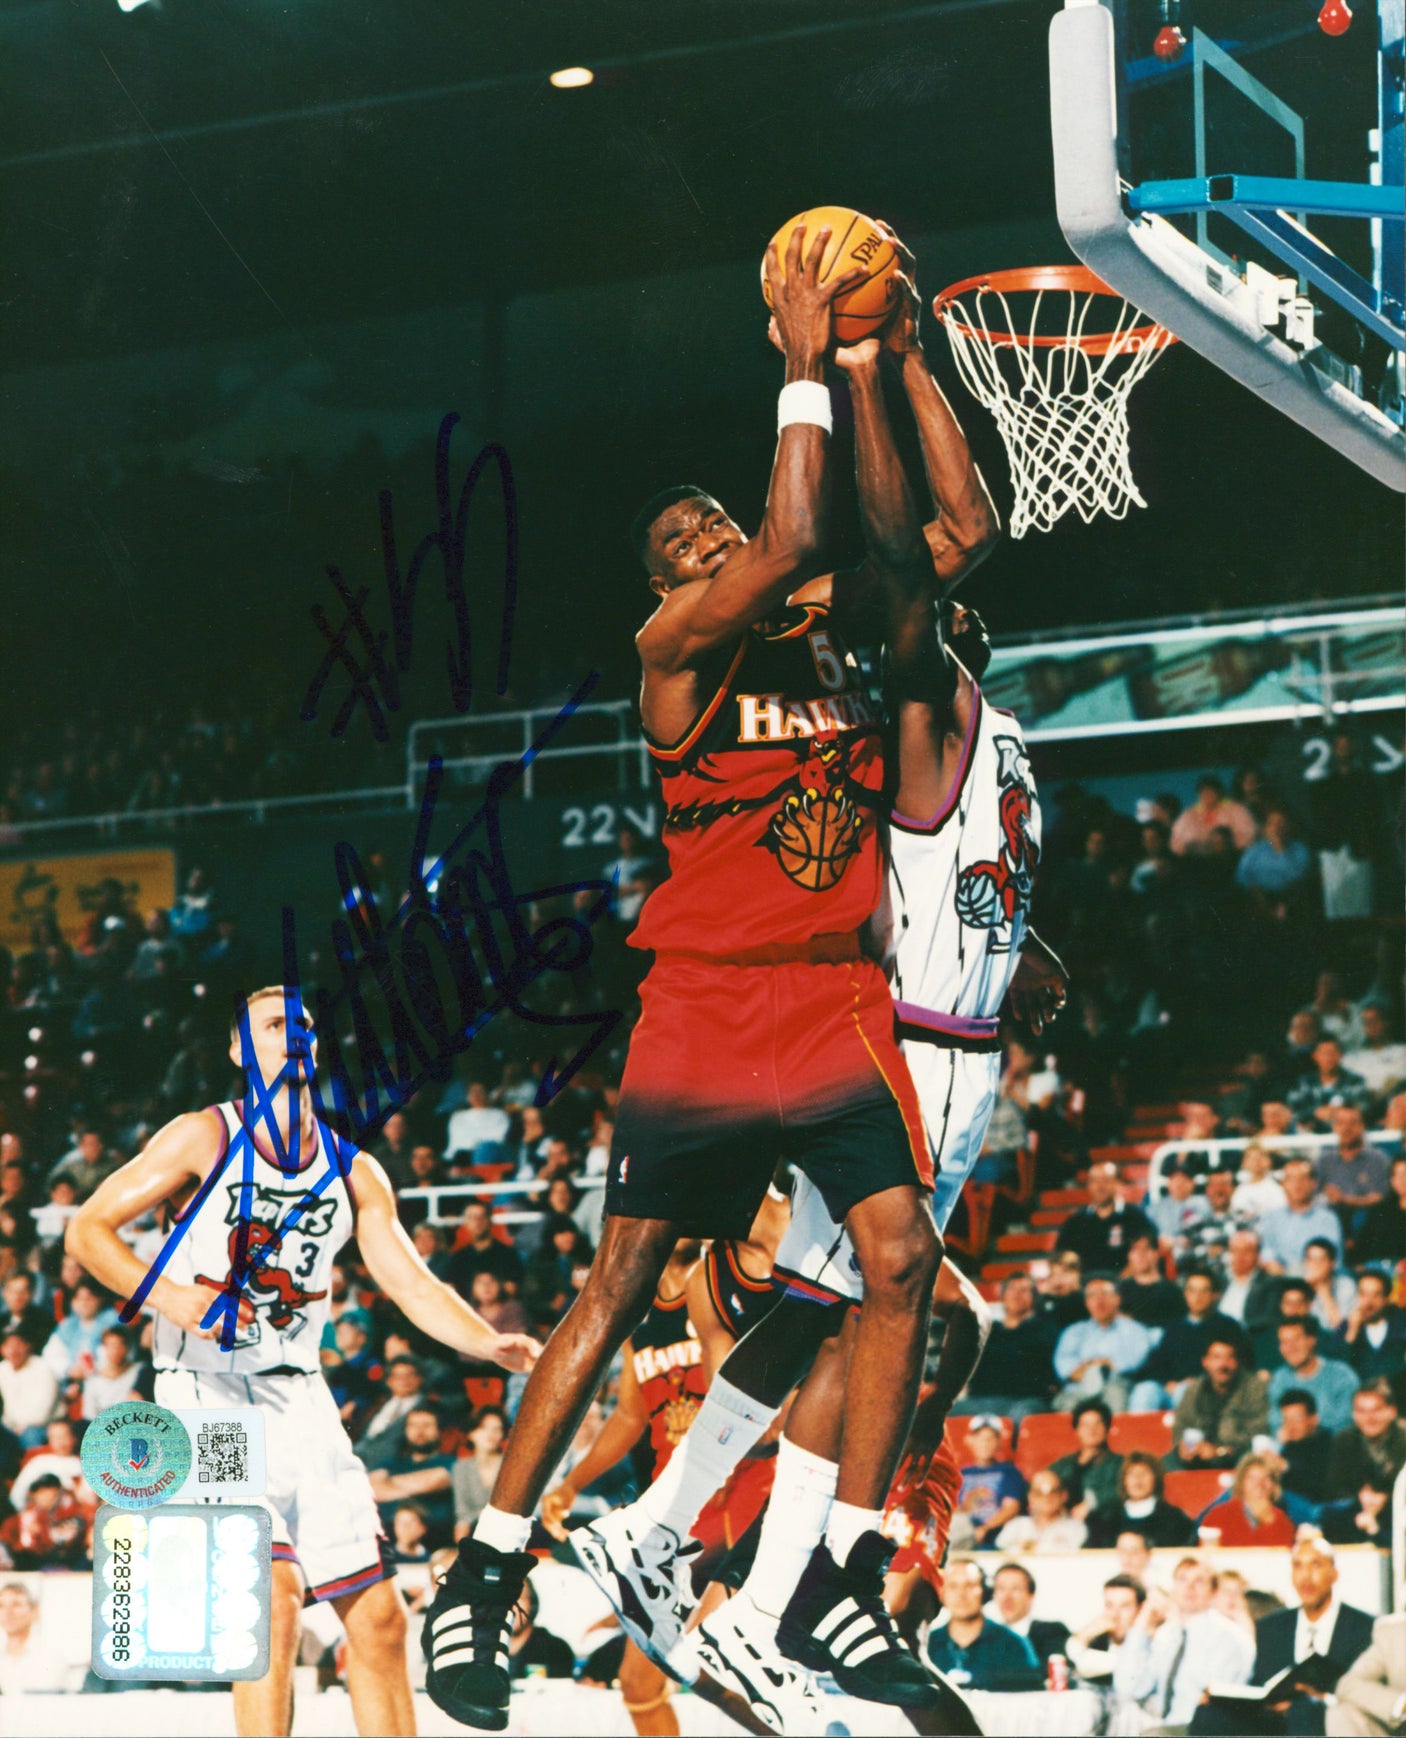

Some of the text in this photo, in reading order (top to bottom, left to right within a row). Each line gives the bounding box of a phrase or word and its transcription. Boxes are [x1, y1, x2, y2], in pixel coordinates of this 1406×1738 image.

[850, 232, 884, 266] SPAL
[808, 630, 848, 692] 5
[736, 692, 874, 744] HAWK
[1302, 737, 1331, 780] 2
[562, 804, 616, 847] 22
[295, 1241, 320, 1278] 3
[104, 1411, 172, 1436] BECKETT
[202, 1422, 243, 1433] BJ67388
[100, 1469, 176, 1498] AUTHENTICATED
[112, 1537, 132, 1662] 228362986
